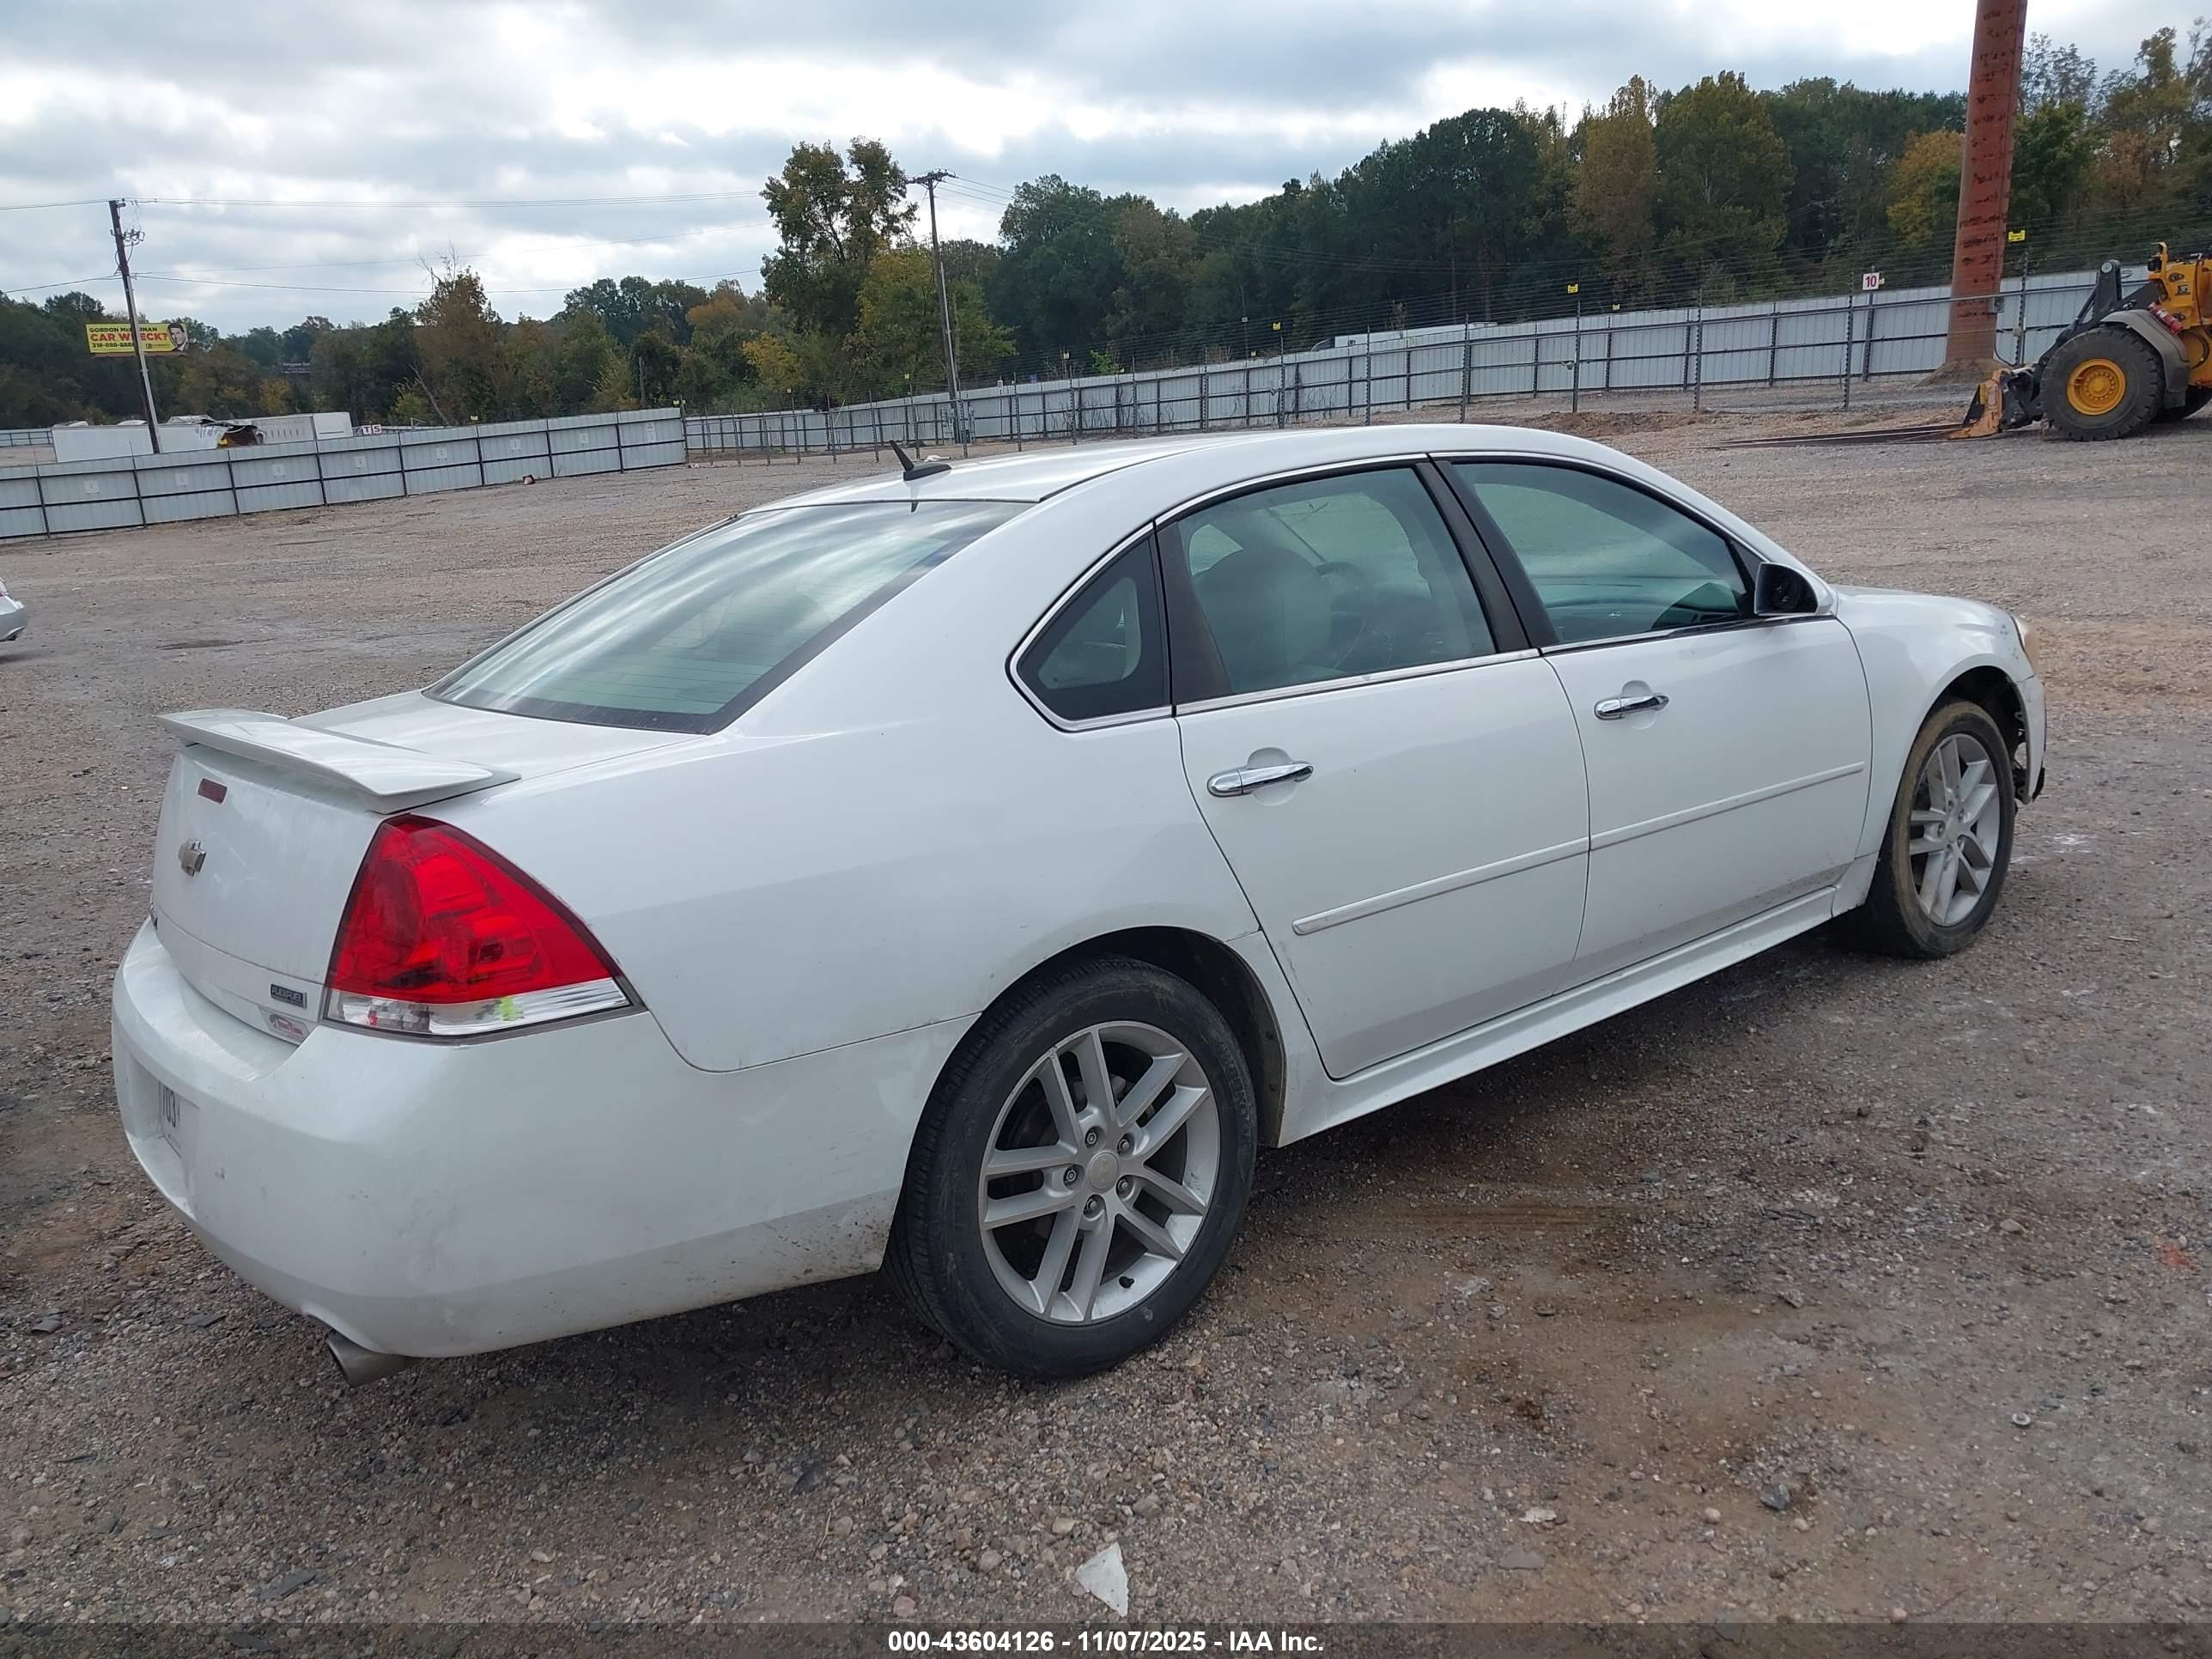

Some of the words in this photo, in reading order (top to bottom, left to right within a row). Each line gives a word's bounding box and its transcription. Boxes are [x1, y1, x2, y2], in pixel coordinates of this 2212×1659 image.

[1865, 275, 1877, 288] 10
[90, 333, 116, 342] CAR
[118, 332, 167, 341] WECK?
